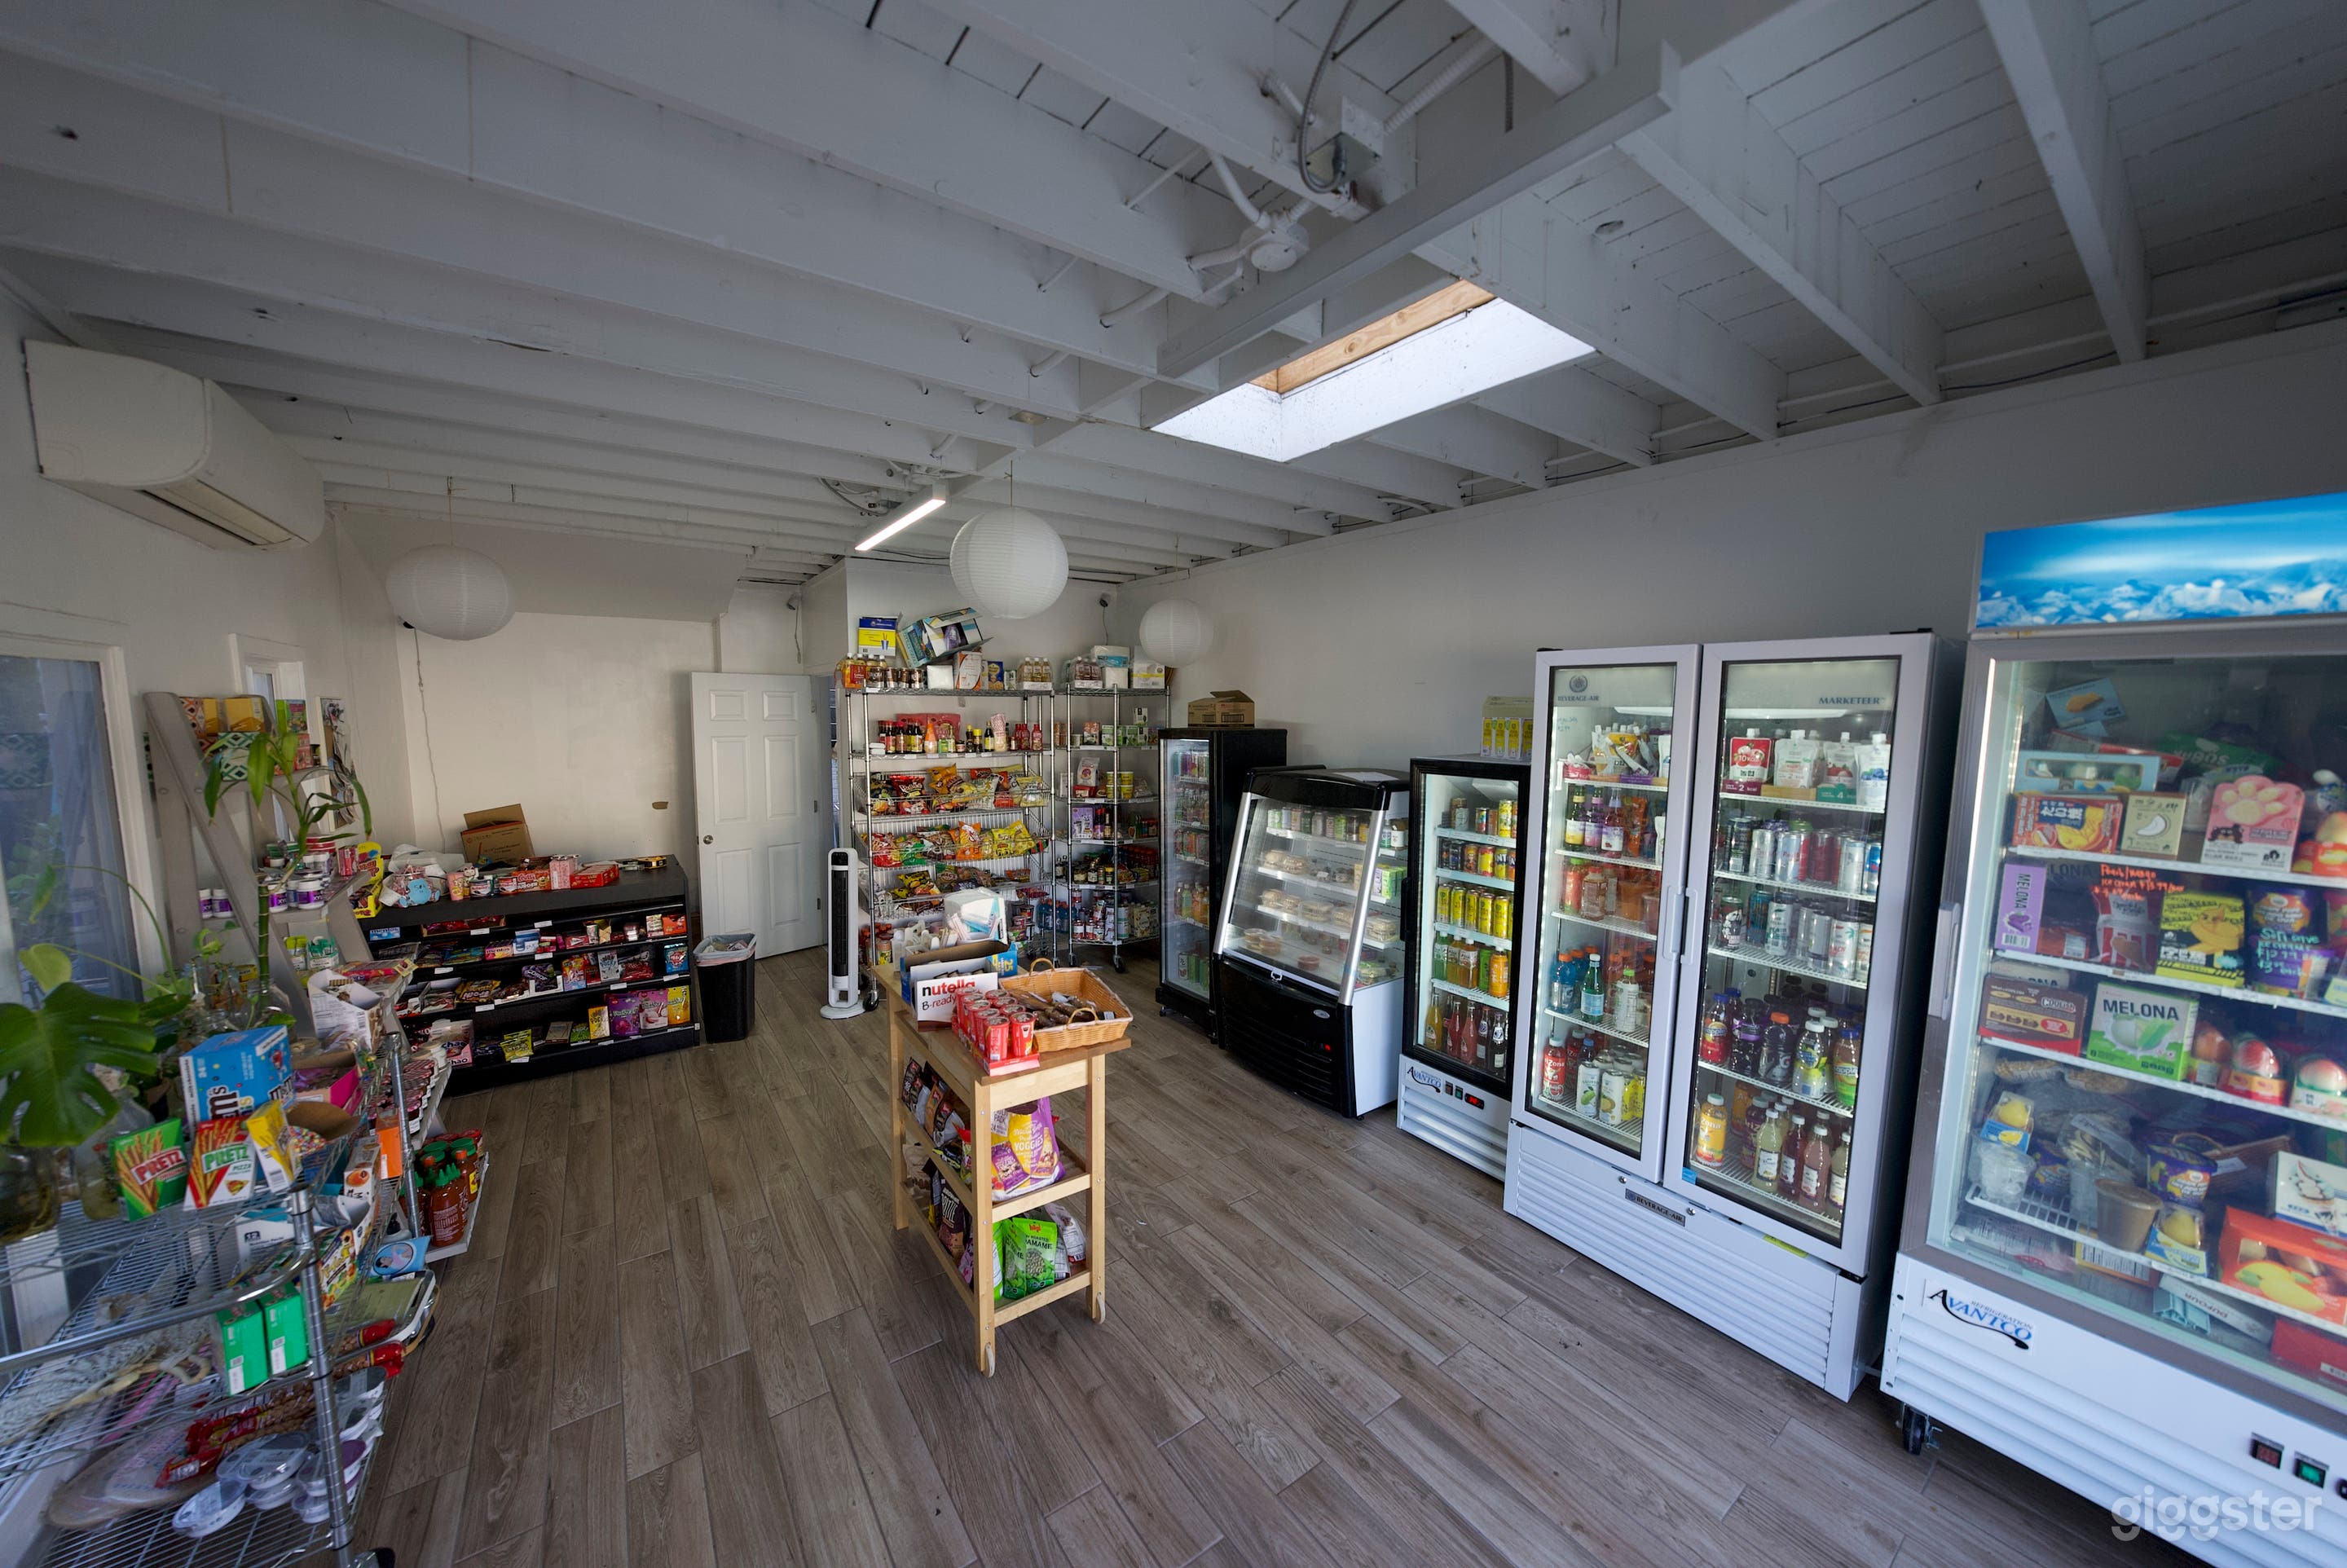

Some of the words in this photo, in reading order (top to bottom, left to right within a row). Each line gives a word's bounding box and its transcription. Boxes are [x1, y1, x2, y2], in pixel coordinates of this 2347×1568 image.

[2015, 873, 2032, 910] MELONA
[923, 979, 975, 997] nutella
[2103, 998, 2180, 1021] MELONA
[1407, 1066, 1442, 1093] AVANTCO
[135, 1150, 186, 1183] PRETZ
[205, 1143, 249, 1170] PRETZ
[1636, 1196, 1684, 1223] BEVERAGE-AIR
[1026, 1239, 1053, 1250] AMAME
[1927, 1289, 2032, 1350] AVANTCO
[1971, 1300, 2033, 1330] REFRIGERATION
